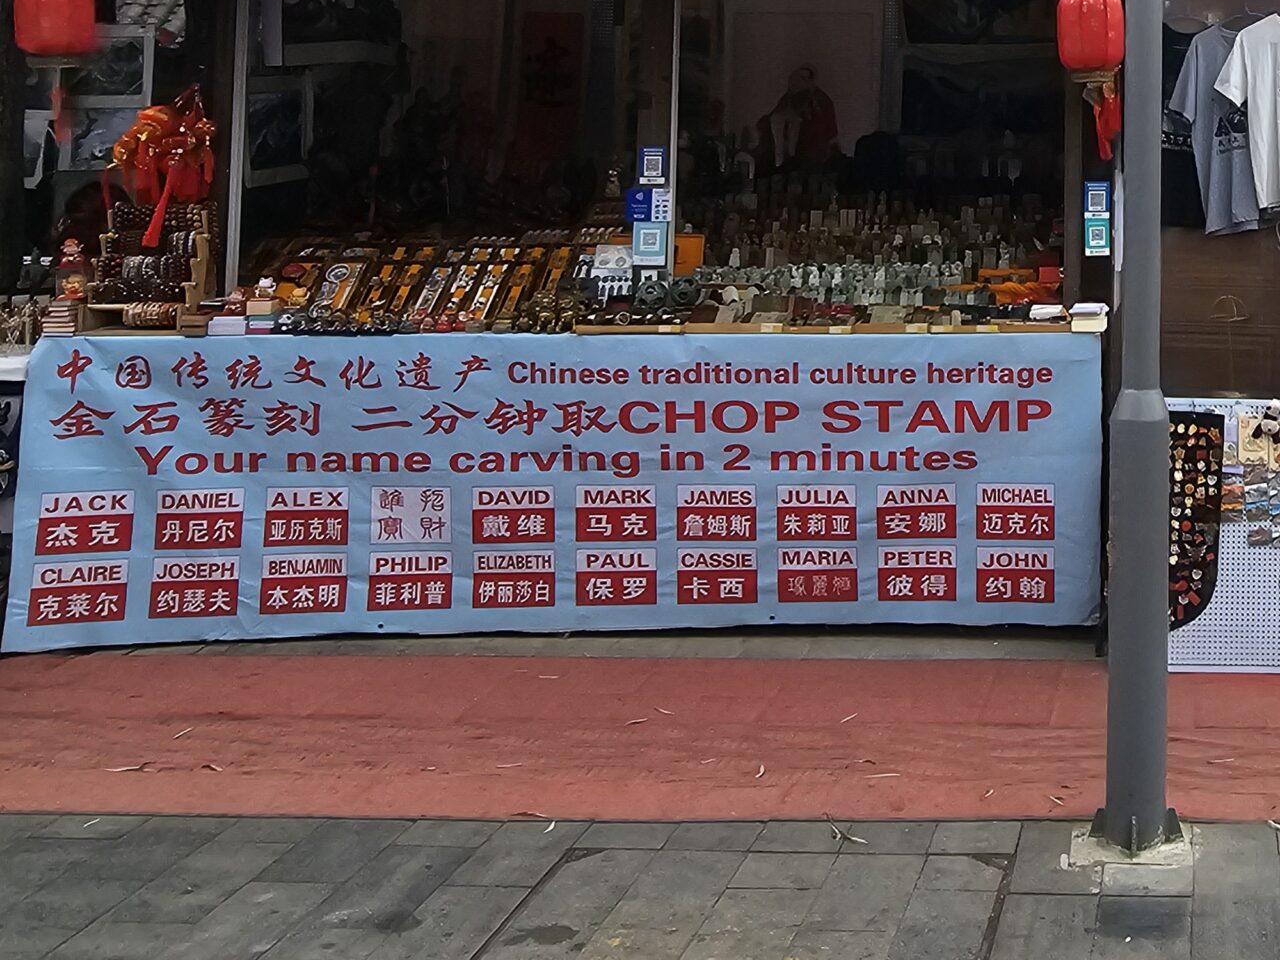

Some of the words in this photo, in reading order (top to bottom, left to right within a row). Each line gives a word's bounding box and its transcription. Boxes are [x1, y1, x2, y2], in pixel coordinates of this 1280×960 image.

[56, 349, 492, 395] 中国传统文化遗产
[508, 361, 629, 386] Chinese
[639, 361, 799, 386] traditional
[809, 362, 917, 385] culture
[927, 362, 1054, 391] heritage
[50, 398, 322, 440] 金石篆刻
[821, 399, 1054, 434] STAMP
[136, 445, 267, 476] Your
[286, 450, 432, 474] name
[449, 444, 641, 479] carving
[660, 444, 704, 472] in
[722, 444, 752, 472] 2
[770, 442, 980, 472] minutes
[45, 494, 129, 513] JACK
[161, 492, 241, 510] DANIEL
[272, 490, 344, 508] ALEX
[478, 488, 551, 507] DAVID
[583, 488, 651, 505] MARK
[683, 488, 753, 506] JAMES
[781, 488, 850, 505] JULIA
[883, 487, 949, 505] ANNA
[981, 487, 1053, 504] MICHAEL
[45, 520, 120, 547] 杰克
[161, 518, 236, 543] 丹尼尔
[269, 517, 343, 542] 亚历克斯
[482, 514, 547, 538] 戴维
[587, 513, 649, 536] 马克
[682, 513, 752, 537] 詹姆斯
[783, 513, 851, 535] 朱莉亚
[884, 512, 946, 534] 安娜
[982, 512, 1050, 535] 迈克尔
[268, 558, 343, 576] BENJAMIN
[376, 556, 448, 573] PHILIP
[477, 554, 552, 571] ELIZABETH
[586, 552, 650, 568] PAUL
[681, 551, 753, 569] CASSIE
[782, 551, 853, 565] MARIA
[884, 550, 953, 566] PETER
[982, 551, 1048, 569] JOHN
[40, 564, 122, 584] CLAIRE
[156, 561, 235, 580] JOSEPH
[266, 584, 340, 609] 本杰明
[374, 581, 446, 607] 菲利普
[477, 579, 550, 604] 伊丽莎白
[586, 576, 648, 600] 保罗
[683, 576, 746, 600] 卡西
[886, 574, 948, 597] 彼得
[984, 576, 1047, 599] 约翰
[37, 592, 119, 621] 克莱尔
[156, 588, 232, 614] 约瑟夫
